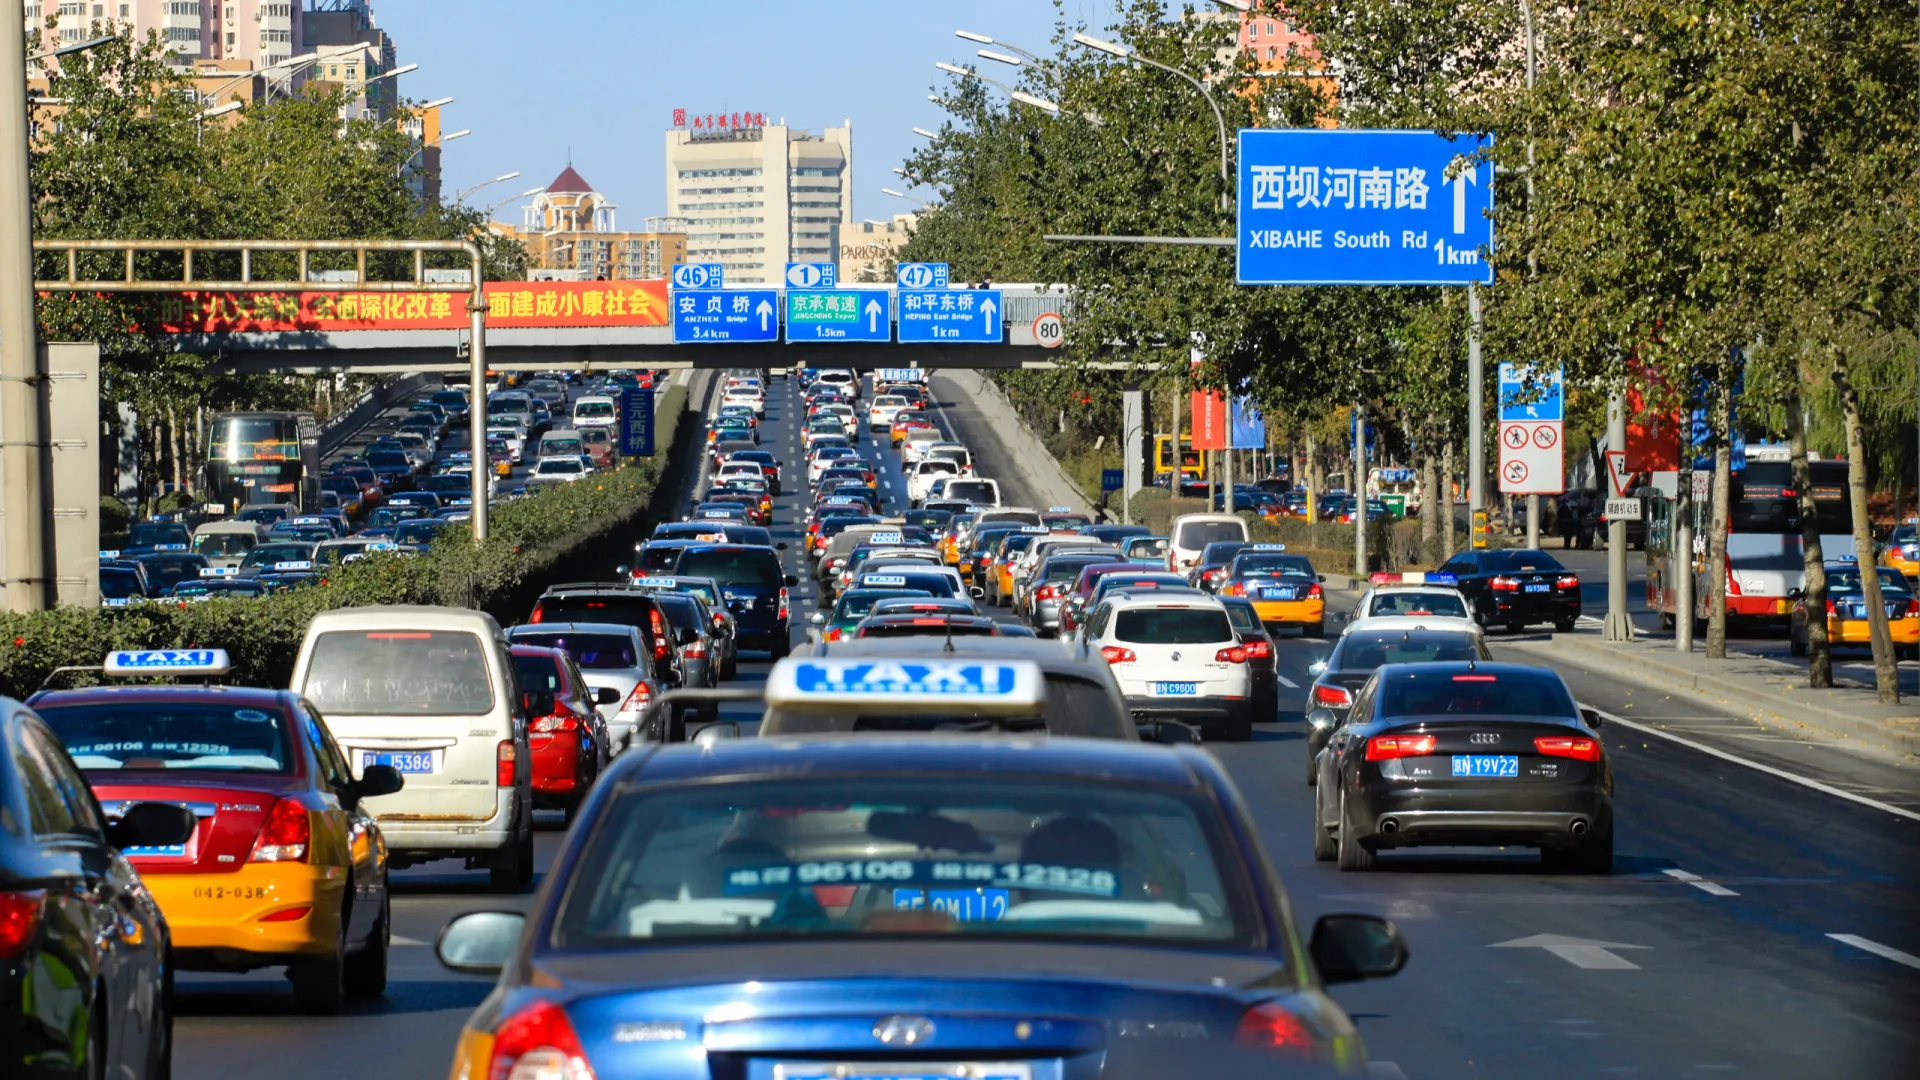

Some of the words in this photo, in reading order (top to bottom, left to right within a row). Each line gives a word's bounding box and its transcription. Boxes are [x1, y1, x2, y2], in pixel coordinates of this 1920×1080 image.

[1250, 164, 1430, 210] 西坝河南路
[1250, 230, 1323, 248] XIBAHE
[1333, 230, 1390, 248] South
[1402, 230, 1428, 248] Rd
[1433, 238, 1479, 265] 1km
[681, 267, 702, 285] 46
[709, 266, 721, 287] 出口
[799, 266, 809, 285] 1
[821, 265, 833, 286] 出口
[905, 267, 927, 285] 47
[934, 266, 946, 287] 出口
[313, 291, 452, 321] 全面深化改革
[679, 295, 750, 314] 安贞桥
[793, 294, 857, 313] 京承高速
[904, 293, 974, 312] 和平东桥
[904, 313, 932, 321] HEPING
[951, 313, 973, 321] Bridge
[815, 324, 846, 337] 1.5km
[931, 325, 960, 338] 1km
[1040, 322, 1059, 338] 80
[628, 393, 648, 450] 三元西桥
[122, 651, 208, 663] TAXI
[811, 663, 1001, 685] TAXI
[93, 741, 144, 752] 96106
[797, 860, 914, 884] 96106
[1001, 864, 1117, 893] 12328
[193, 886, 266, 900] 042-038
